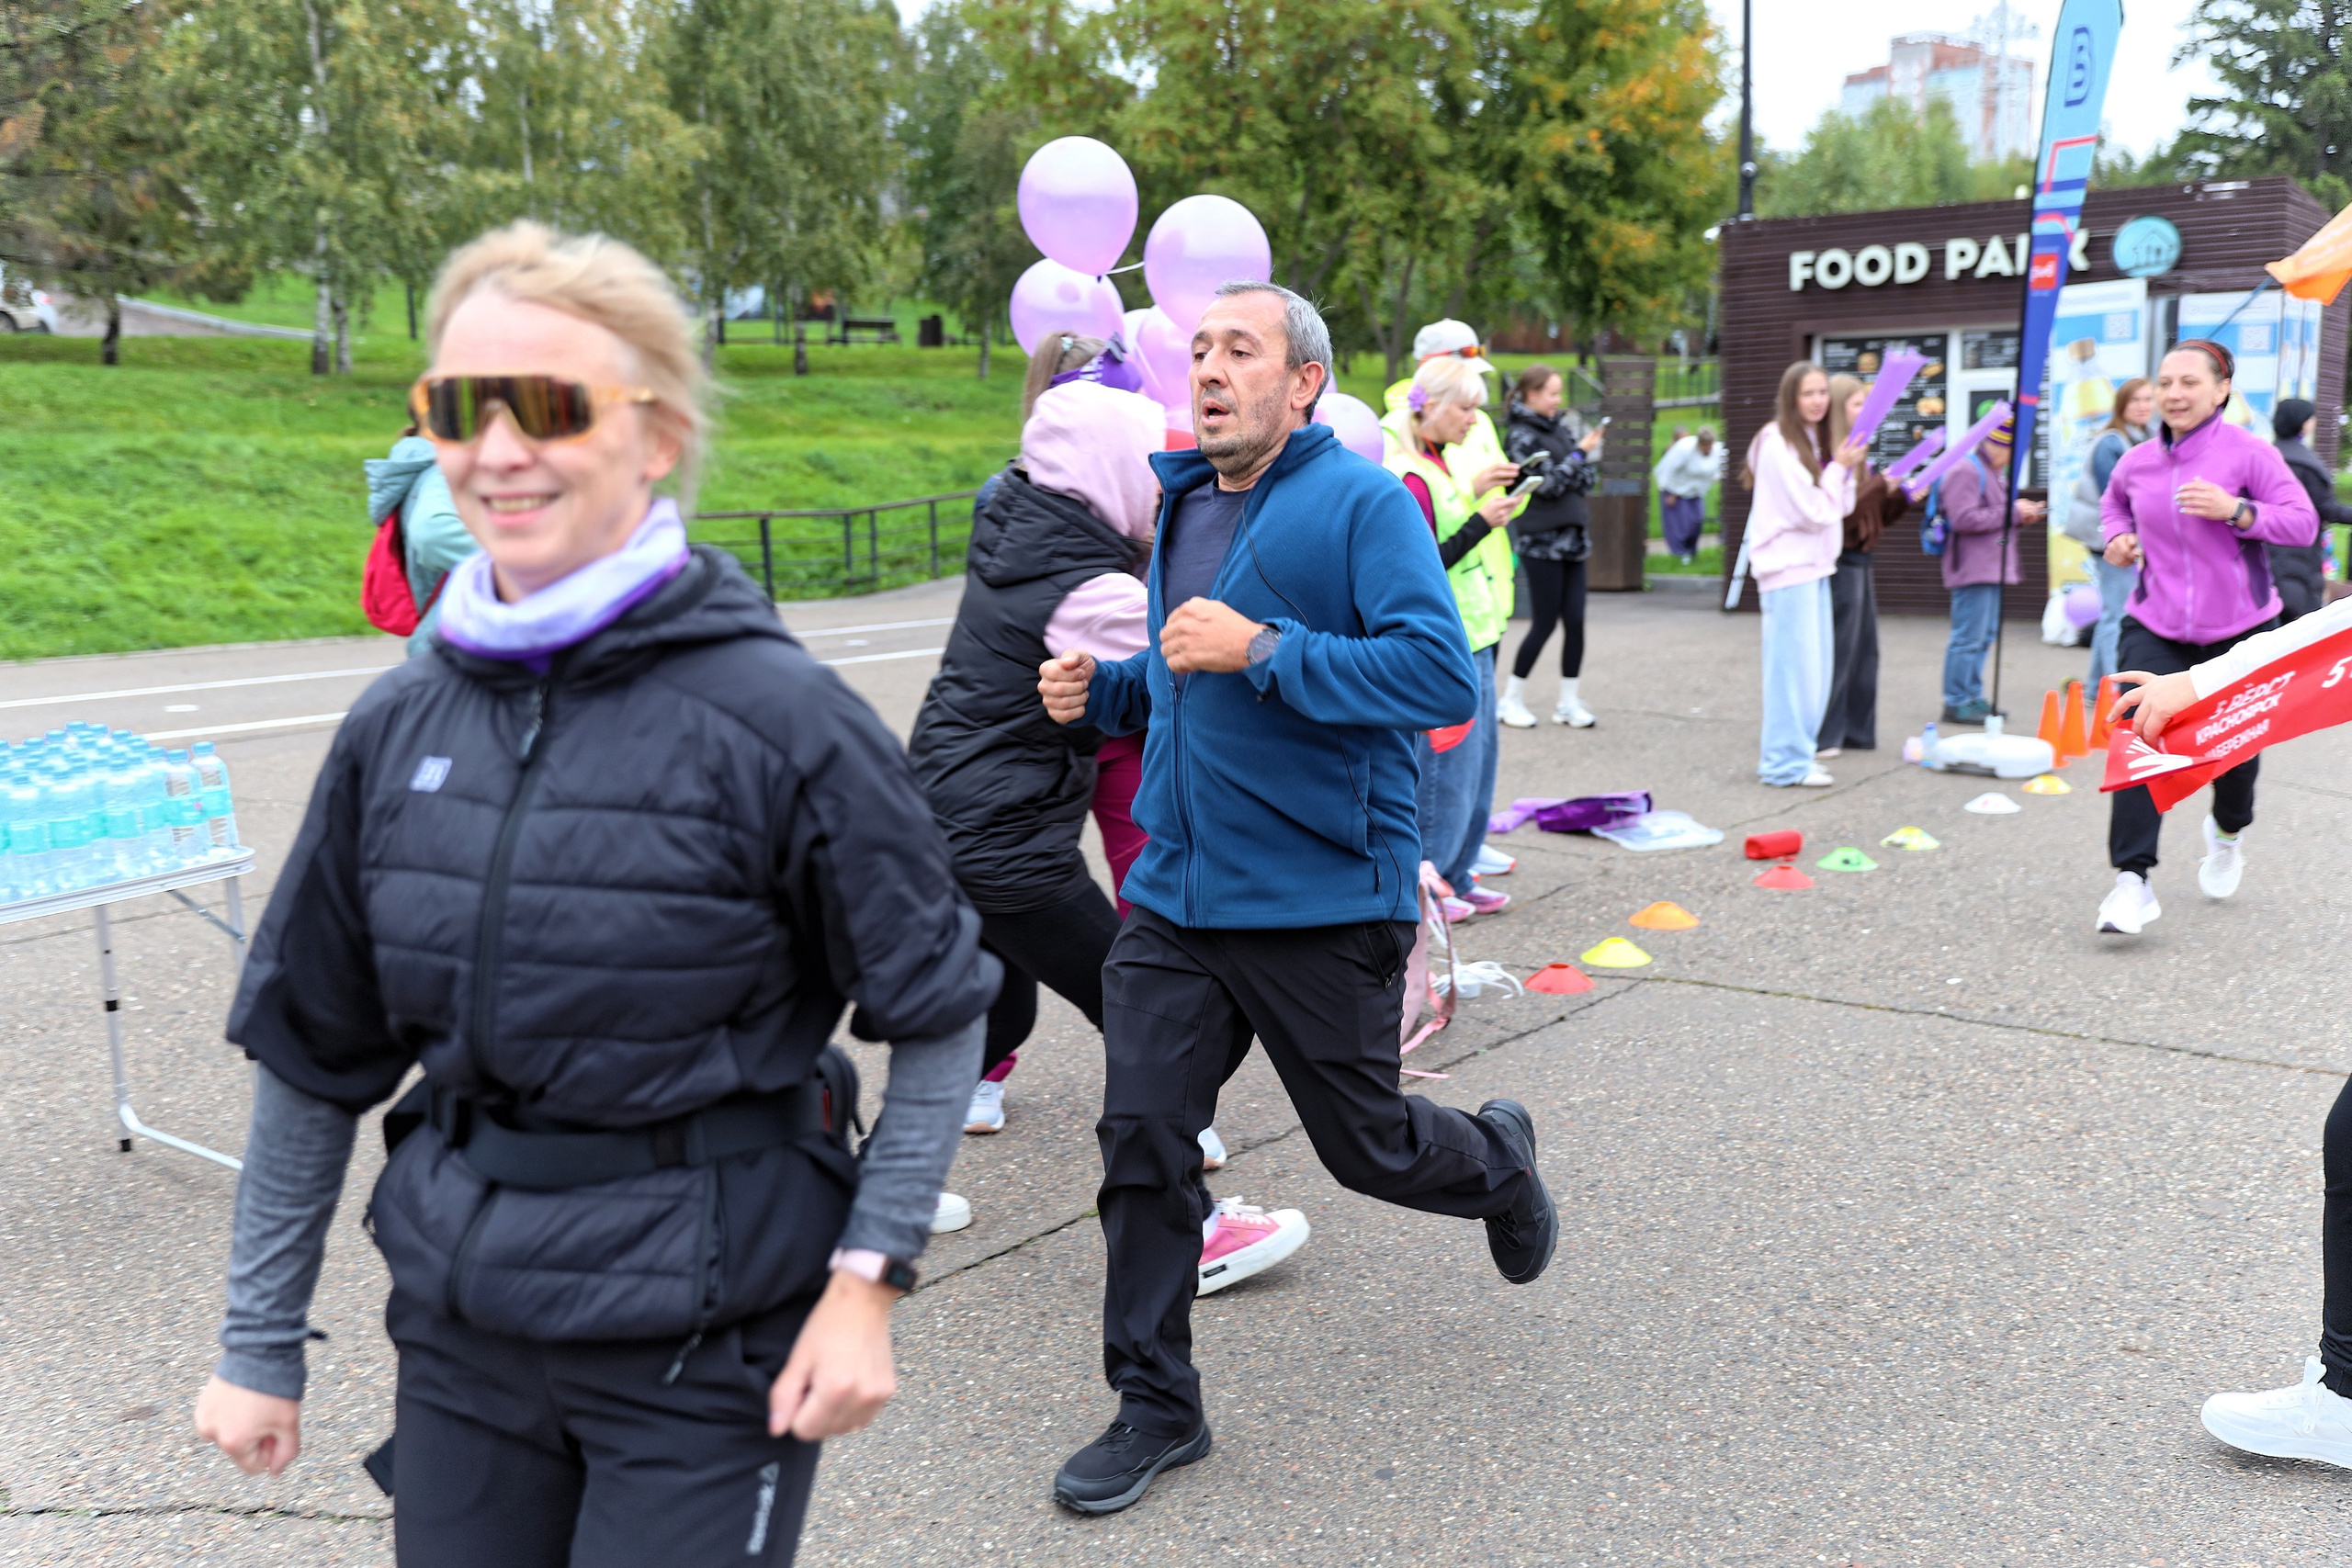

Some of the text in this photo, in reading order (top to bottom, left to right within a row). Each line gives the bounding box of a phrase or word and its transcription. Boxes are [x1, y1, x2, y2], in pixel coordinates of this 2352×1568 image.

[1789, 242, 1930, 292] FOOD
[2195, 692, 2284, 746] КРАСНОЯРСК
[2208, 700, 2228, 720] 5
